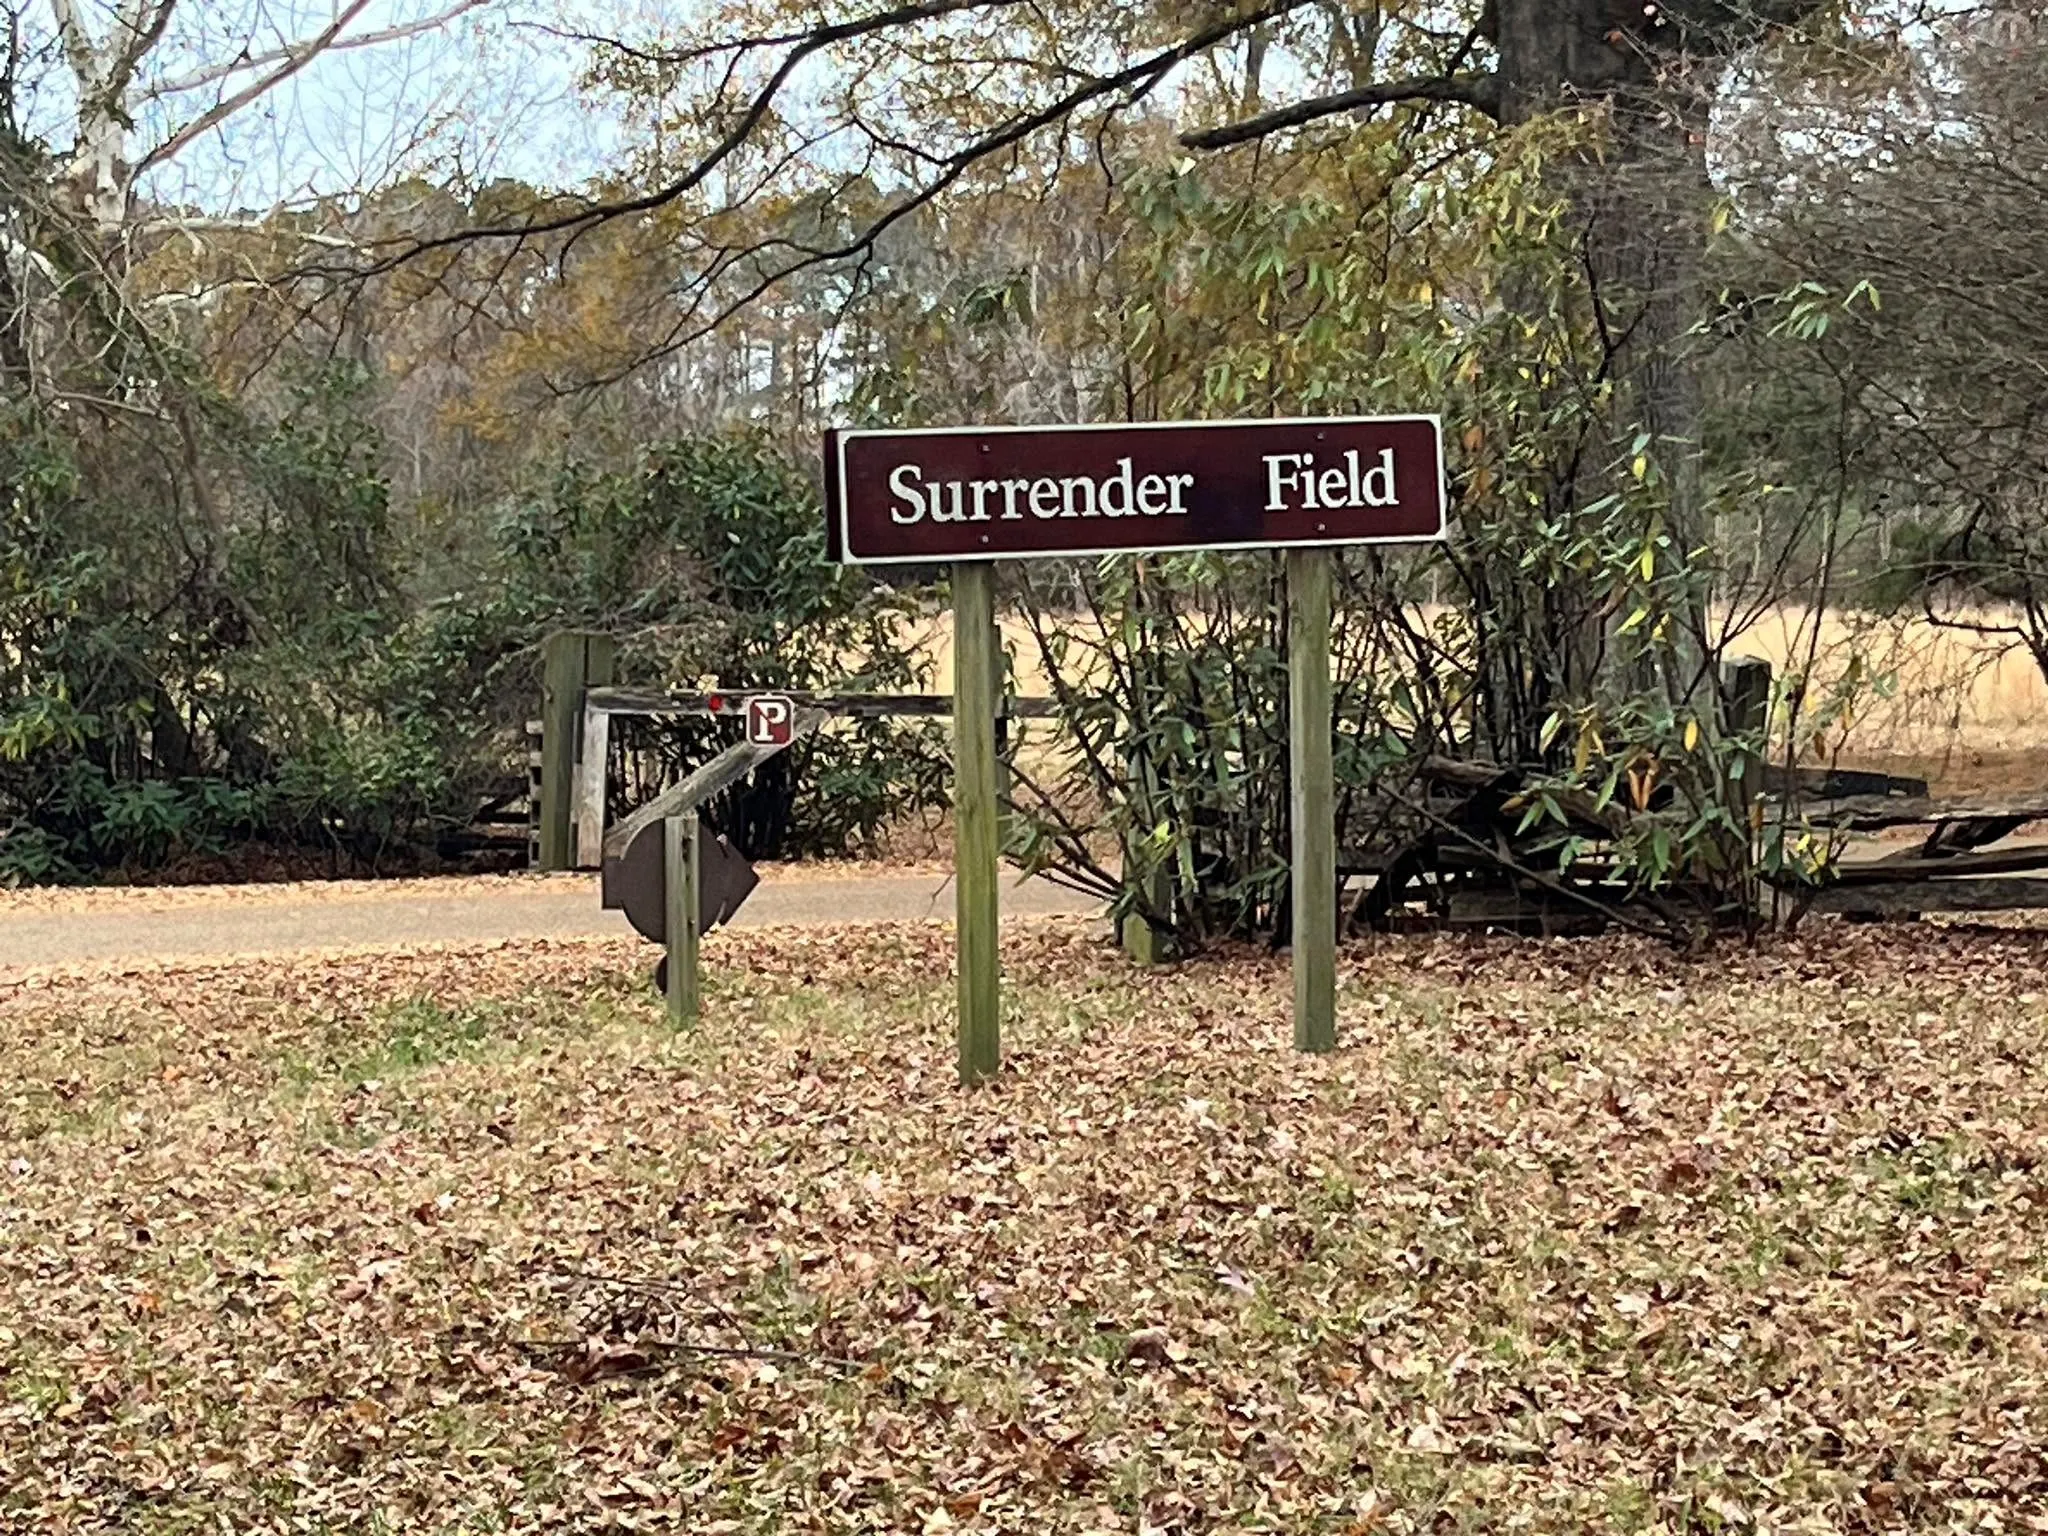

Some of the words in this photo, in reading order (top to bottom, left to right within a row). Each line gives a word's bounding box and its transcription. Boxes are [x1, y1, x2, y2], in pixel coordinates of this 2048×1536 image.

[889, 457, 1194, 524] Surrender
[1262, 448, 1399, 511] Field
[754, 702, 787, 741] P
